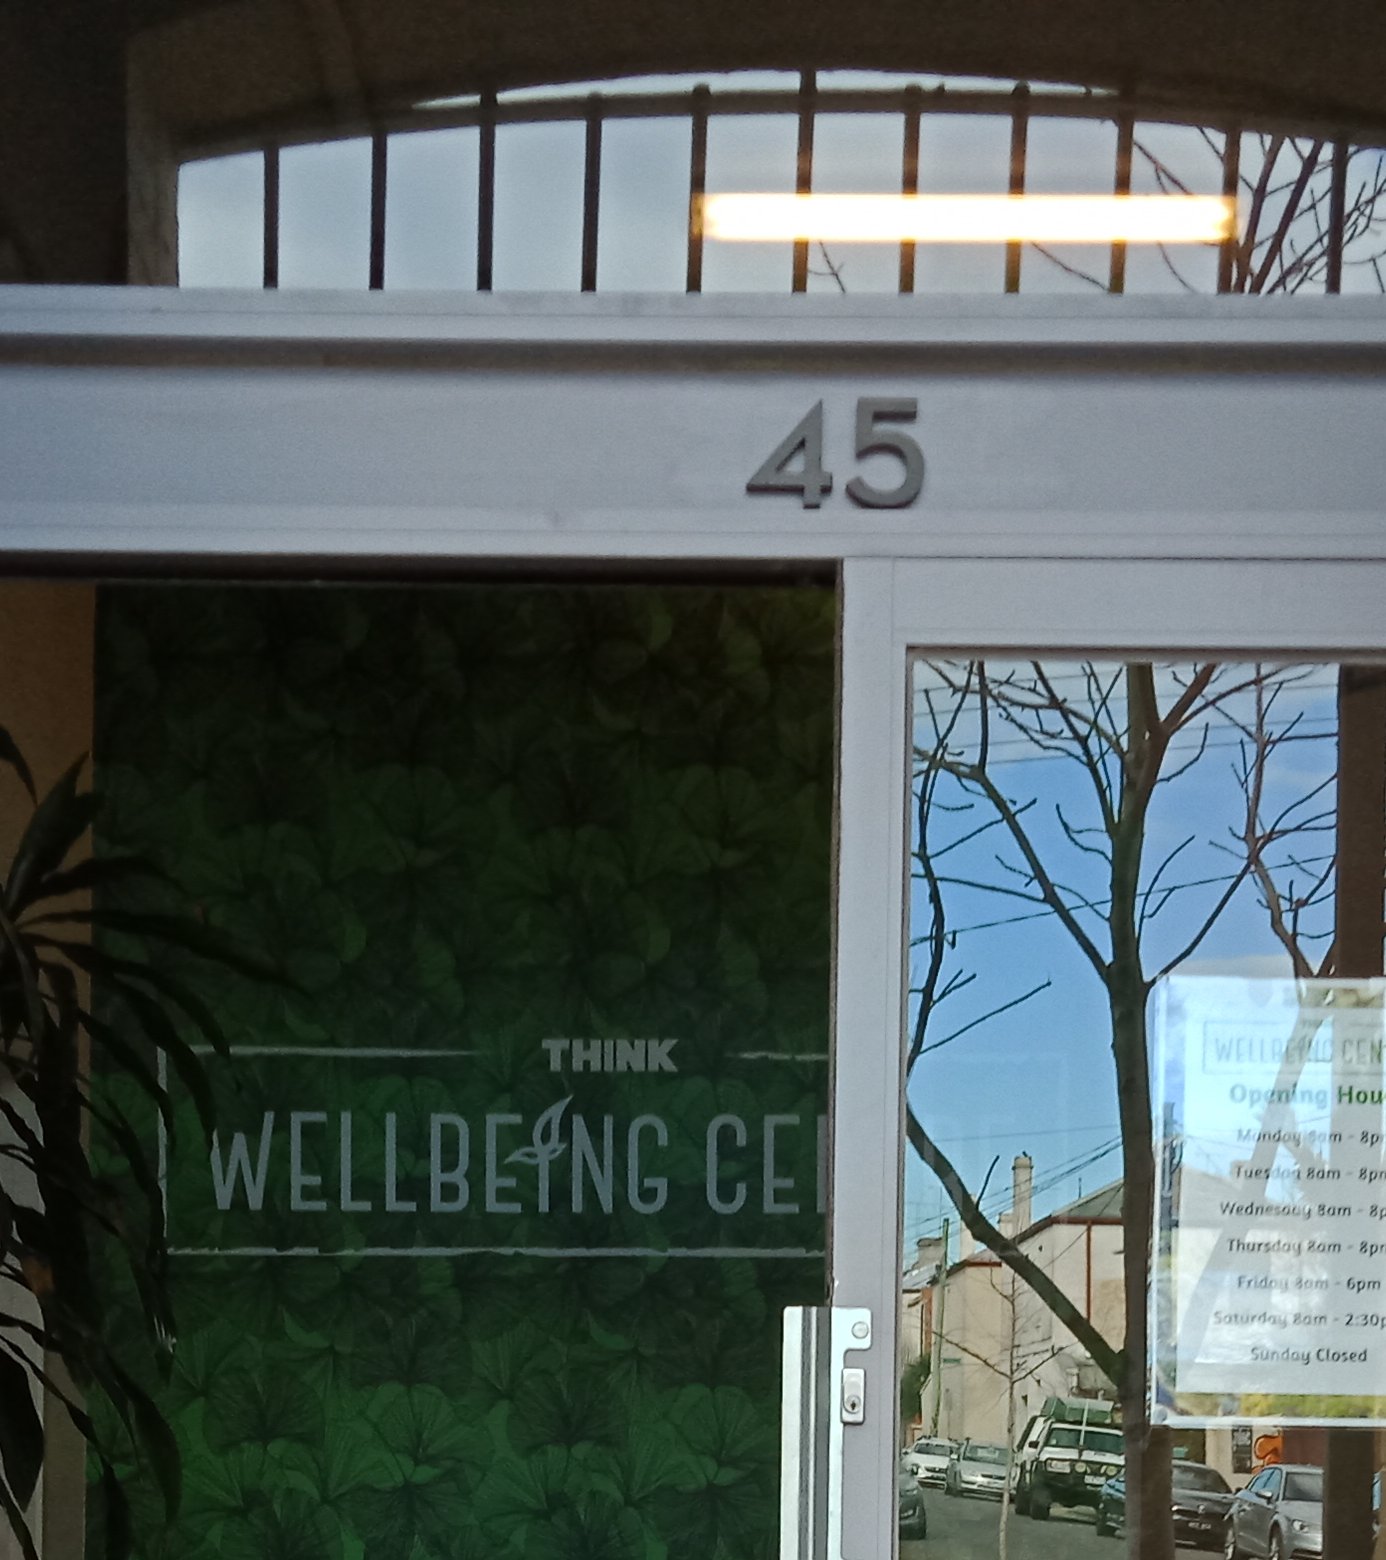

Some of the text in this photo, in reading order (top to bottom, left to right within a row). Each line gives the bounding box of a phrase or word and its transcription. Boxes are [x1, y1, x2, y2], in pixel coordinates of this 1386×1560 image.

[746, 397, 925, 509] 45
[541, 1038, 679, 1073] THINK
[1229, 1082, 1329, 1110] Opening
[212, 1098, 829, 1214] WELLBEING CE
[1305, 1167, 1341, 1181] 8am
[1317, 1203, 1352, 1217] 8am
[1227, 1237, 1302, 1257] Thursday
[1236, 1275, 1289, 1294] Friday
[1346, 1276, 1381, 1294] 6pm
[1213, 1310, 1288, 1330] Saturday
[1292, 1312, 1328, 1326] 8am
[1249, 1346, 1368, 1366] Sunday Closed
